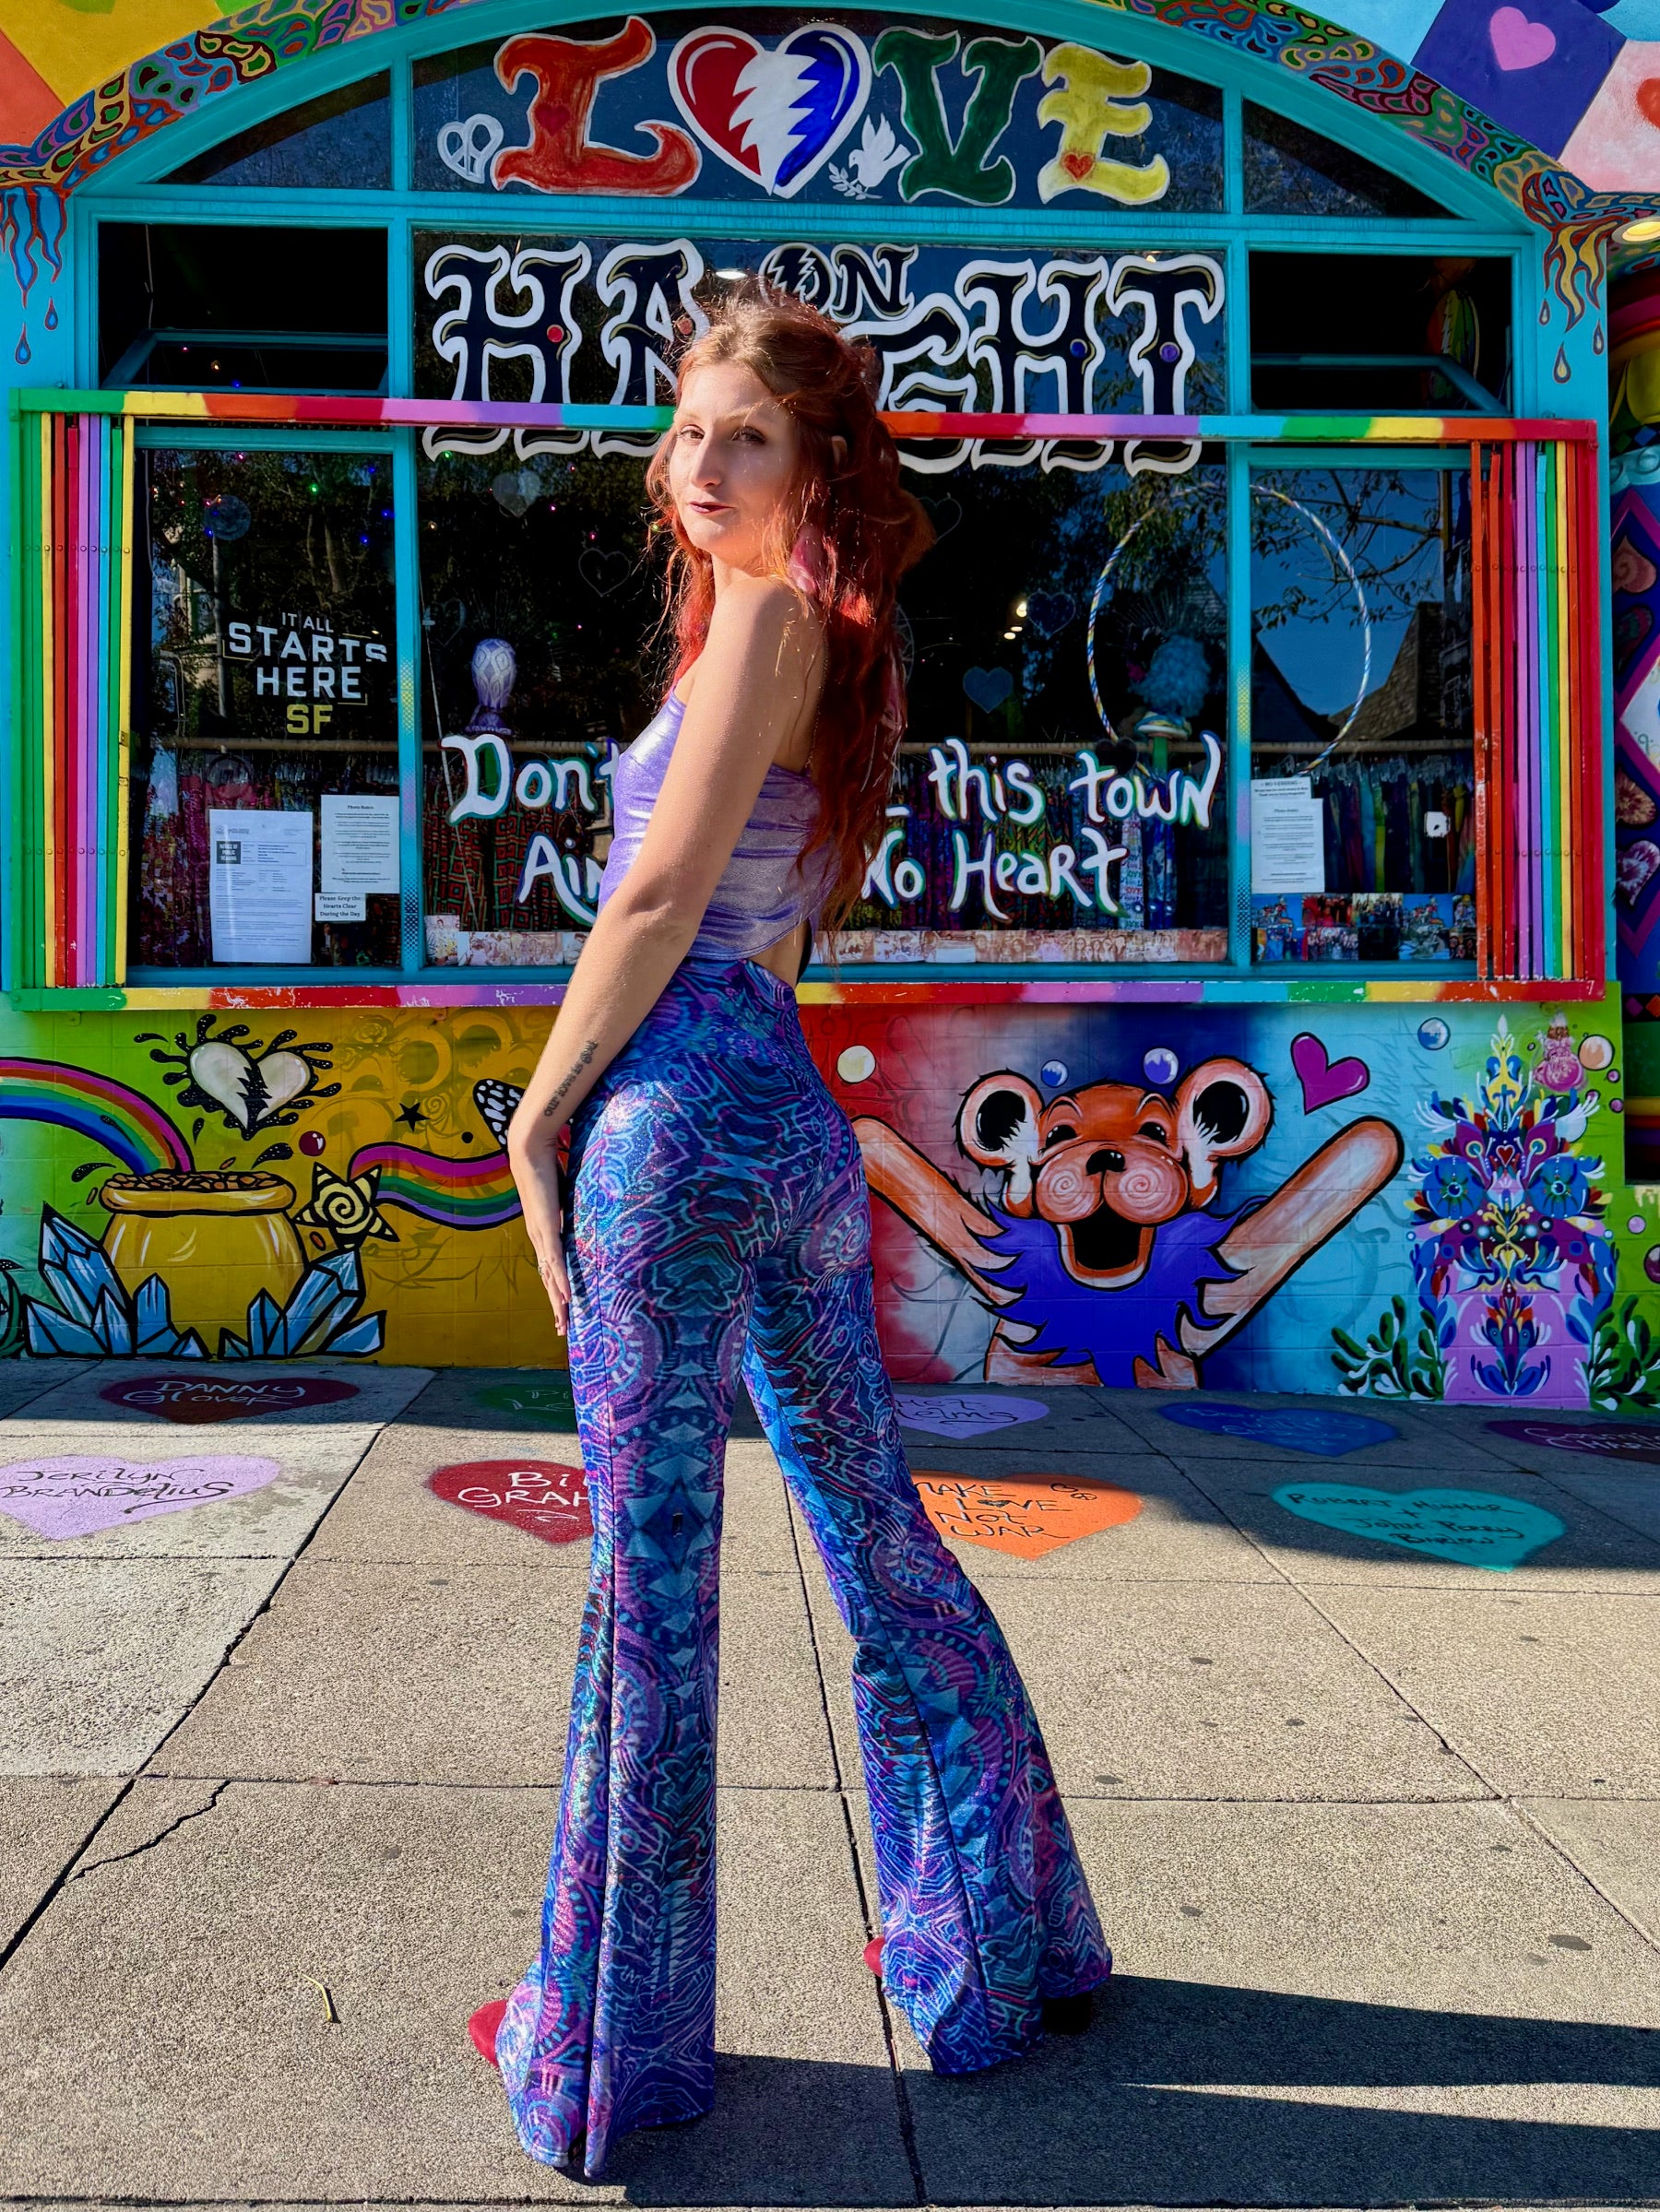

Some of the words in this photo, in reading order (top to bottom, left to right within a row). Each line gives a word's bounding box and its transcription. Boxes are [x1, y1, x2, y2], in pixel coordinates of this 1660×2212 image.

[759, 242, 919, 324] ON
[424, 238, 1225, 476] HAGHT
[229, 621, 387, 662] STARTS
[282, 612, 297, 626] IT
[303, 616, 334, 633] ALL
[256, 667, 362, 699] HERE
[287, 704, 333, 734] SF
[928, 736, 1046, 824] this
